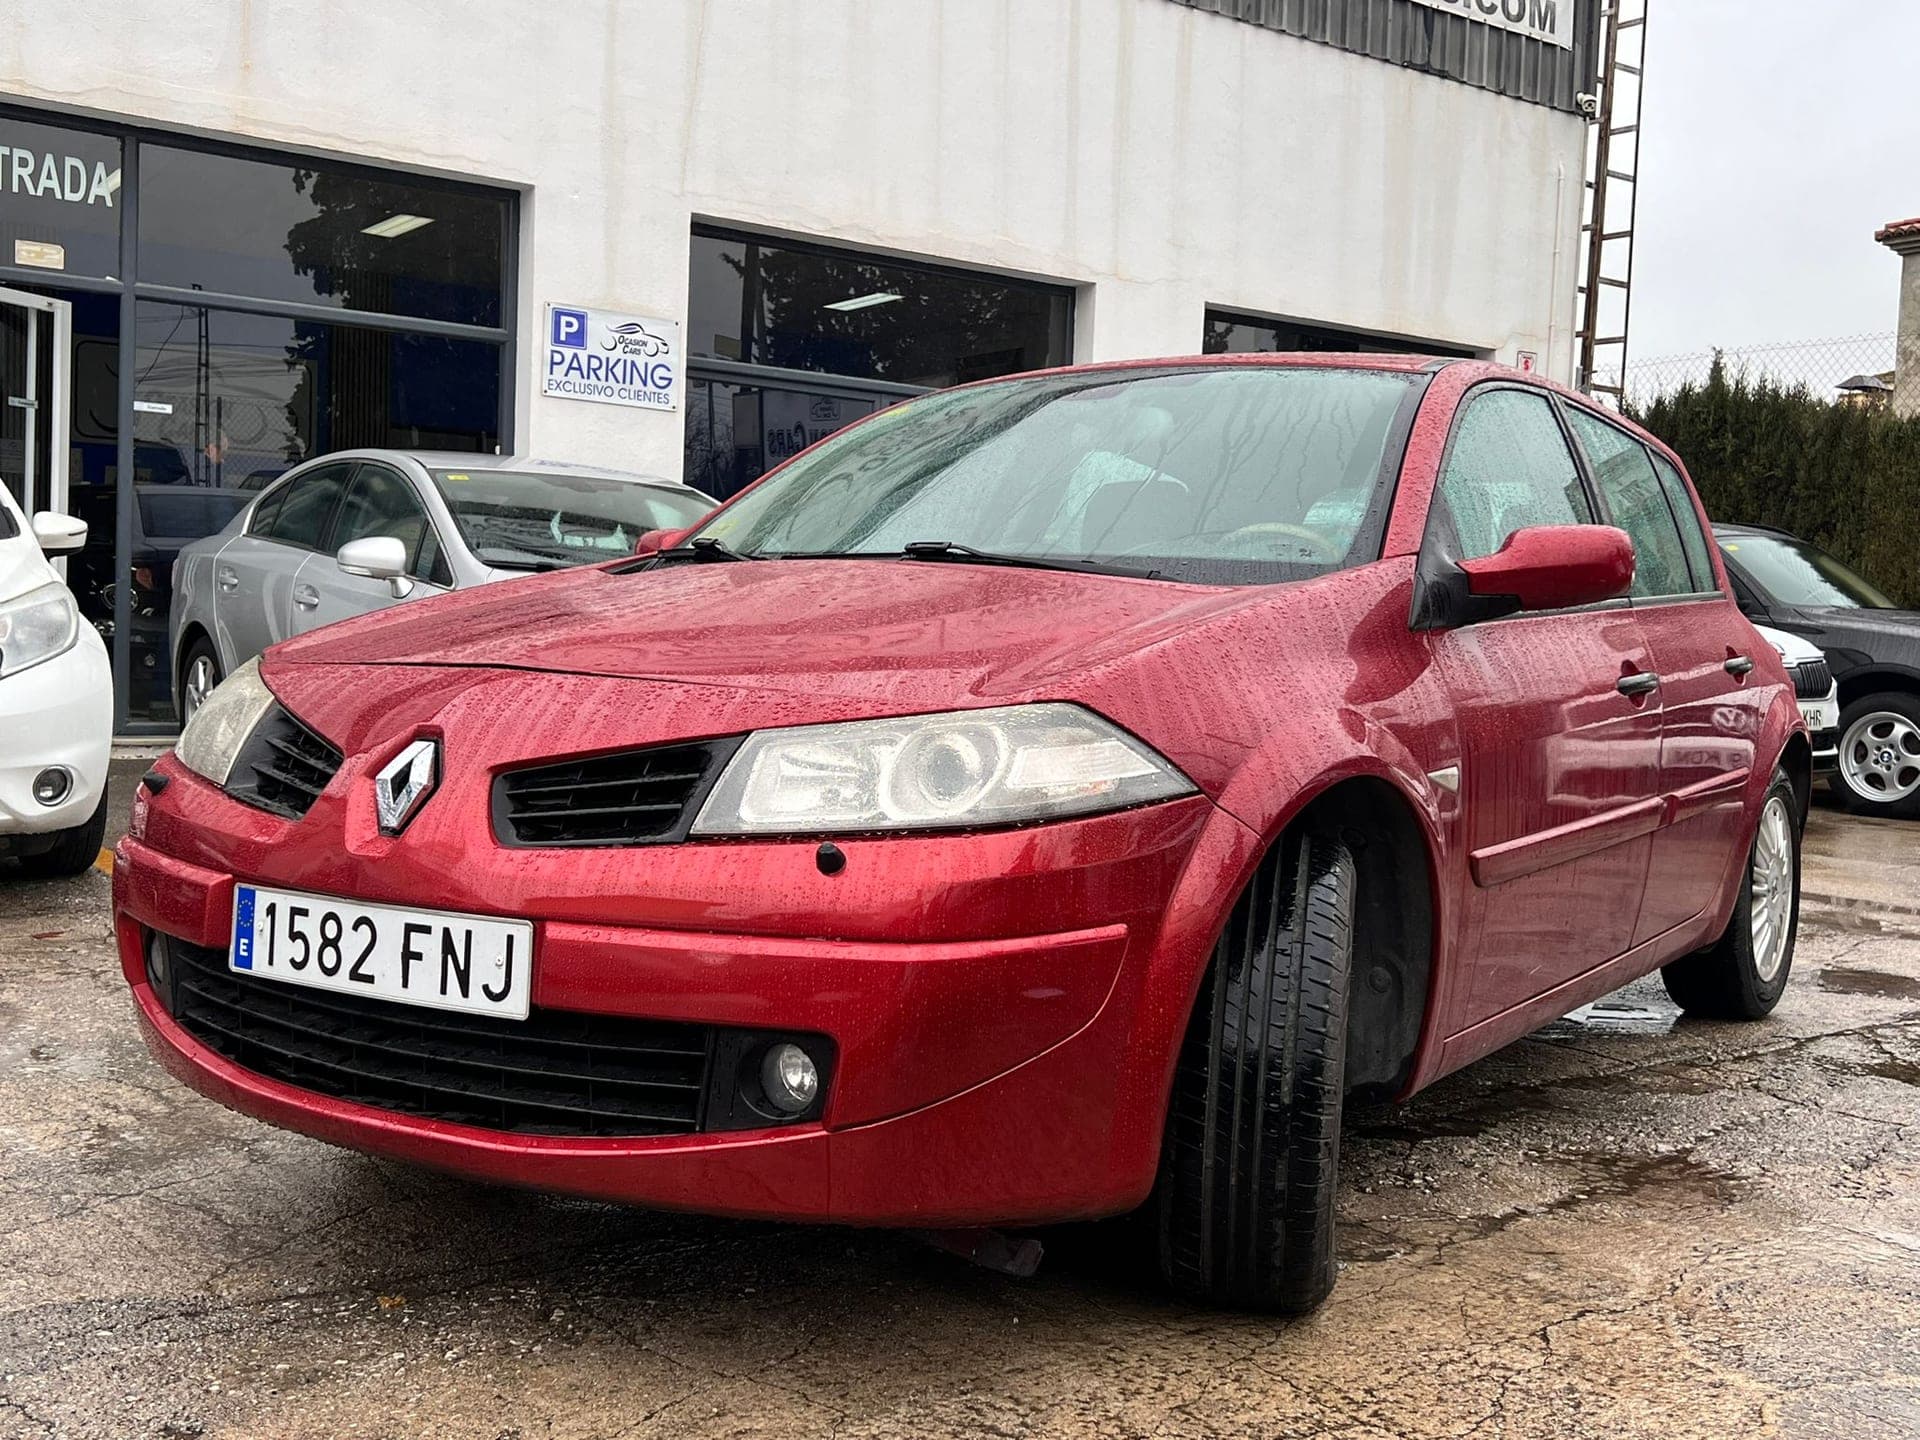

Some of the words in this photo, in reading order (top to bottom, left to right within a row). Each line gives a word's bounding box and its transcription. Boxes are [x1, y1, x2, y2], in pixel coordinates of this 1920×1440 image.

[560, 315, 579, 341] P
[618, 335, 648, 348] OCASION
[623, 345, 642, 356] CARS
[549, 349, 673, 390] PARKING
[547, 378, 614, 398] EXCLUSIVO
[618, 387, 670, 405] CLIENTES
[239, 938, 249, 956] E
[266, 902, 377, 984] 1582
[401, 922, 514, 1002] FNJ
